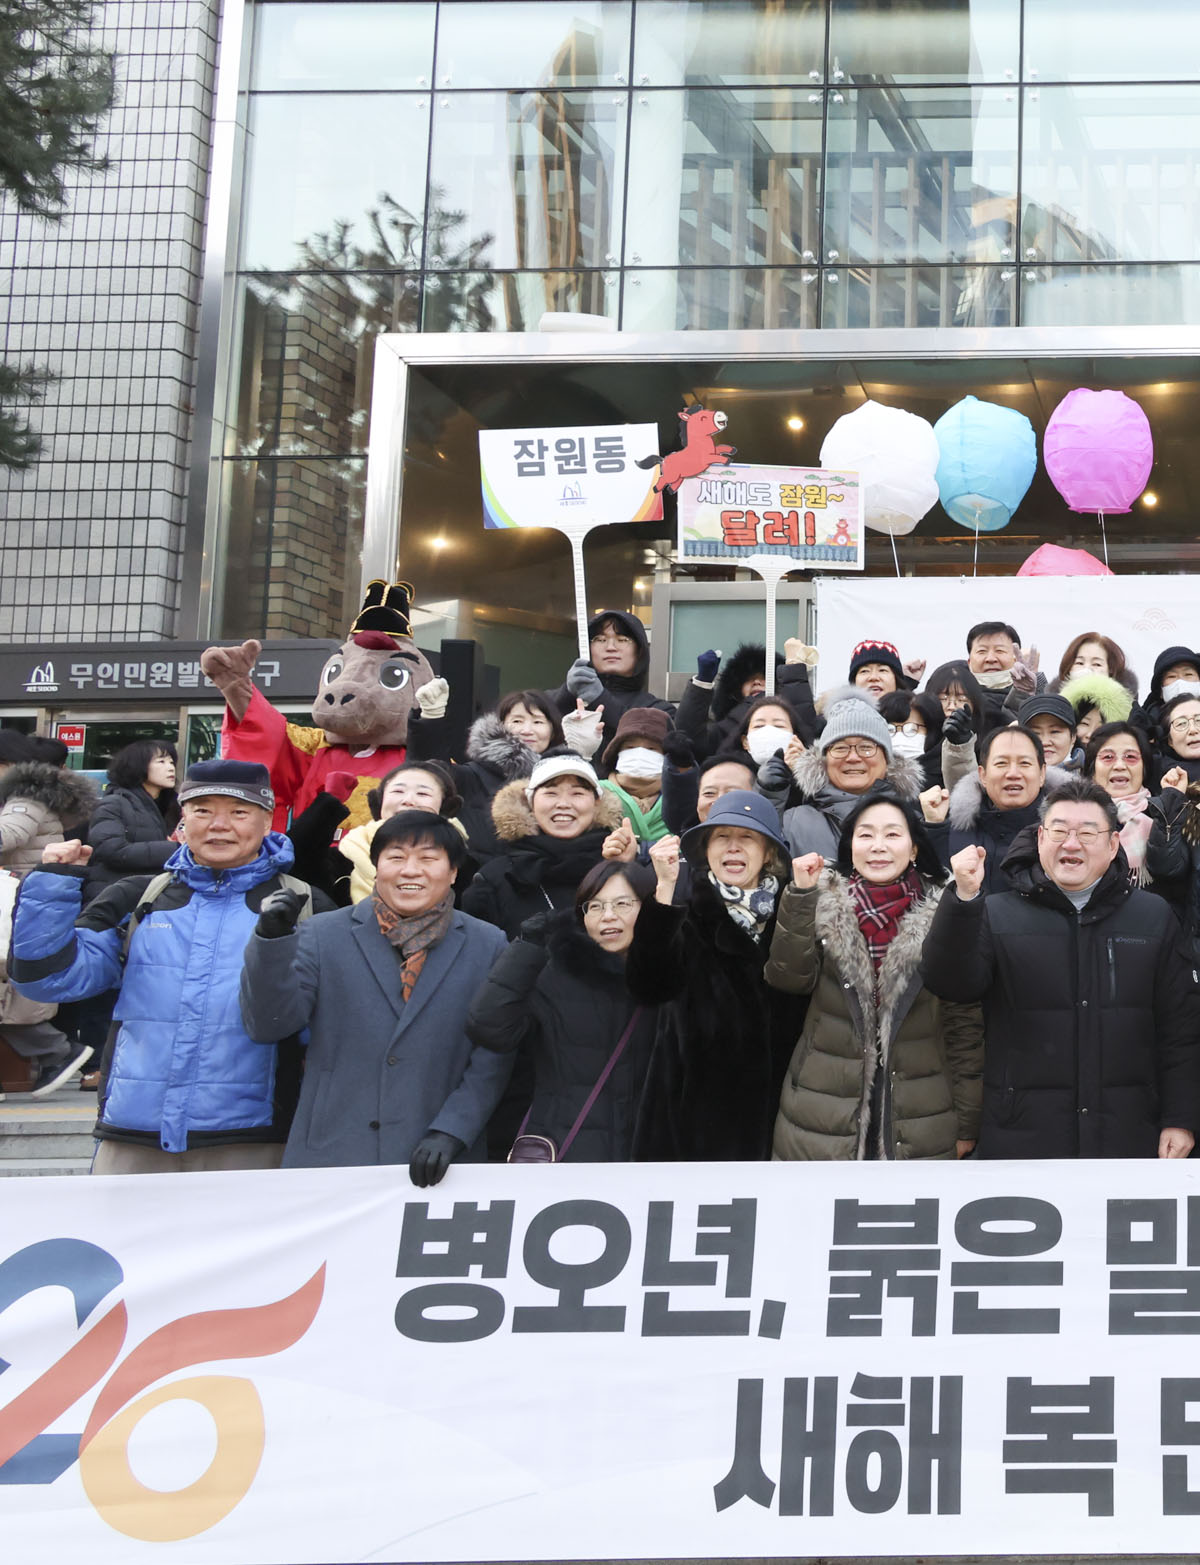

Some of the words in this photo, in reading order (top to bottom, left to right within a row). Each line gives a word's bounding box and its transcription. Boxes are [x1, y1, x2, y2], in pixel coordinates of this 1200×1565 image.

[514, 436, 626, 477] 잠원동
[698, 480, 772, 506] 새해도
[779, 484, 844, 509] 잠원~
[720, 510, 816, 546] 달려!
[69, 661, 280, 689] 무인민원발구
[190, 786, 245, 797] CHICAGO
[394, 1197, 787, 1343] 병오년,
[826, 1196, 1063, 1337] 붉은
[713, 1371, 963, 1517] 새해
[1002, 1376, 1118, 1517] 복
